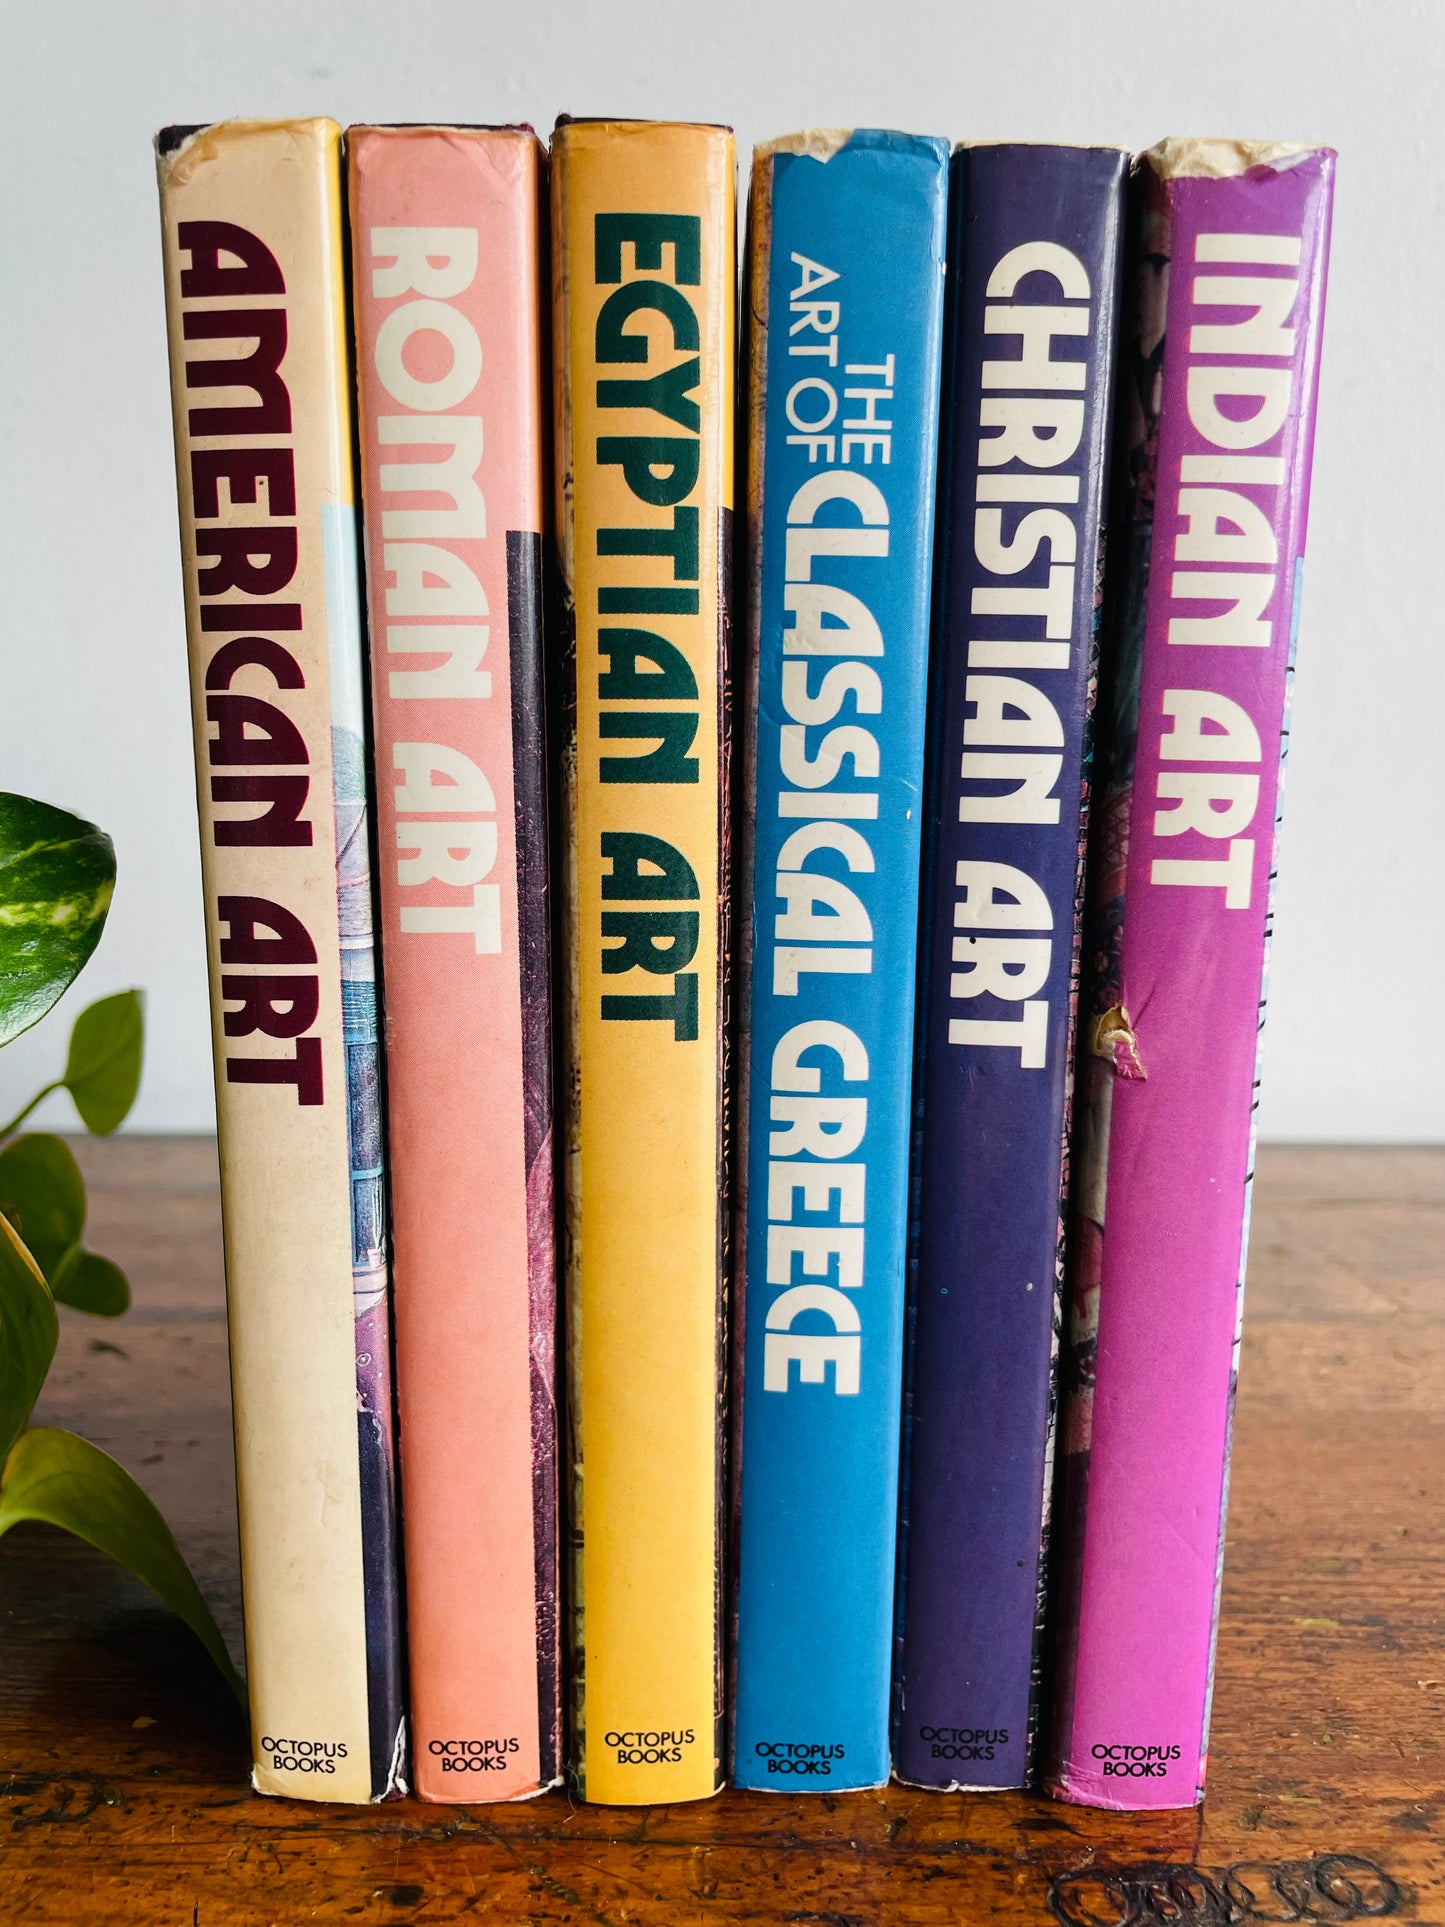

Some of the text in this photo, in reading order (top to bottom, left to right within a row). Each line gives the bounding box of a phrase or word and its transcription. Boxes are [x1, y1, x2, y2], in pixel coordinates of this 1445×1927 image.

[785, 252, 841, 464] ART OF
[842, 354, 895, 464] THE
[1150, 233, 1300, 910] INDIAN ART
[370, 226, 502, 954] ROMAN ART
[595, 213, 701, 1042] EGYPTIAN ART
[178, 220, 324, 1106] AMERICAN ART
[948, 241, 1091, 1069] CHRISTIAN ART
[764, 470, 890, 1395] CLASSICAL GREECE
[604, 1729, 696, 1747] OCTOPUS
[919, 1726, 1009, 1744] OCTOPUS
[261, 1736, 348, 1758] OCTOPUS
[428, 1737, 520, 1755] OCTOPUS
[617, 1747, 682, 1764] BOOKS
[755, 1741, 845, 1759] OCTOPUS
[931, 1743, 995, 1761] BOOKS
[1091, 1744, 1181, 1760] OCTOPUS
[273, 1754, 336, 1774] BOOKS
[441, 1755, 507, 1772] BOOKS
[767, 1759, 832, 1775] BOOKS
[1103, 1761, 1167, 1777] BOOKS
